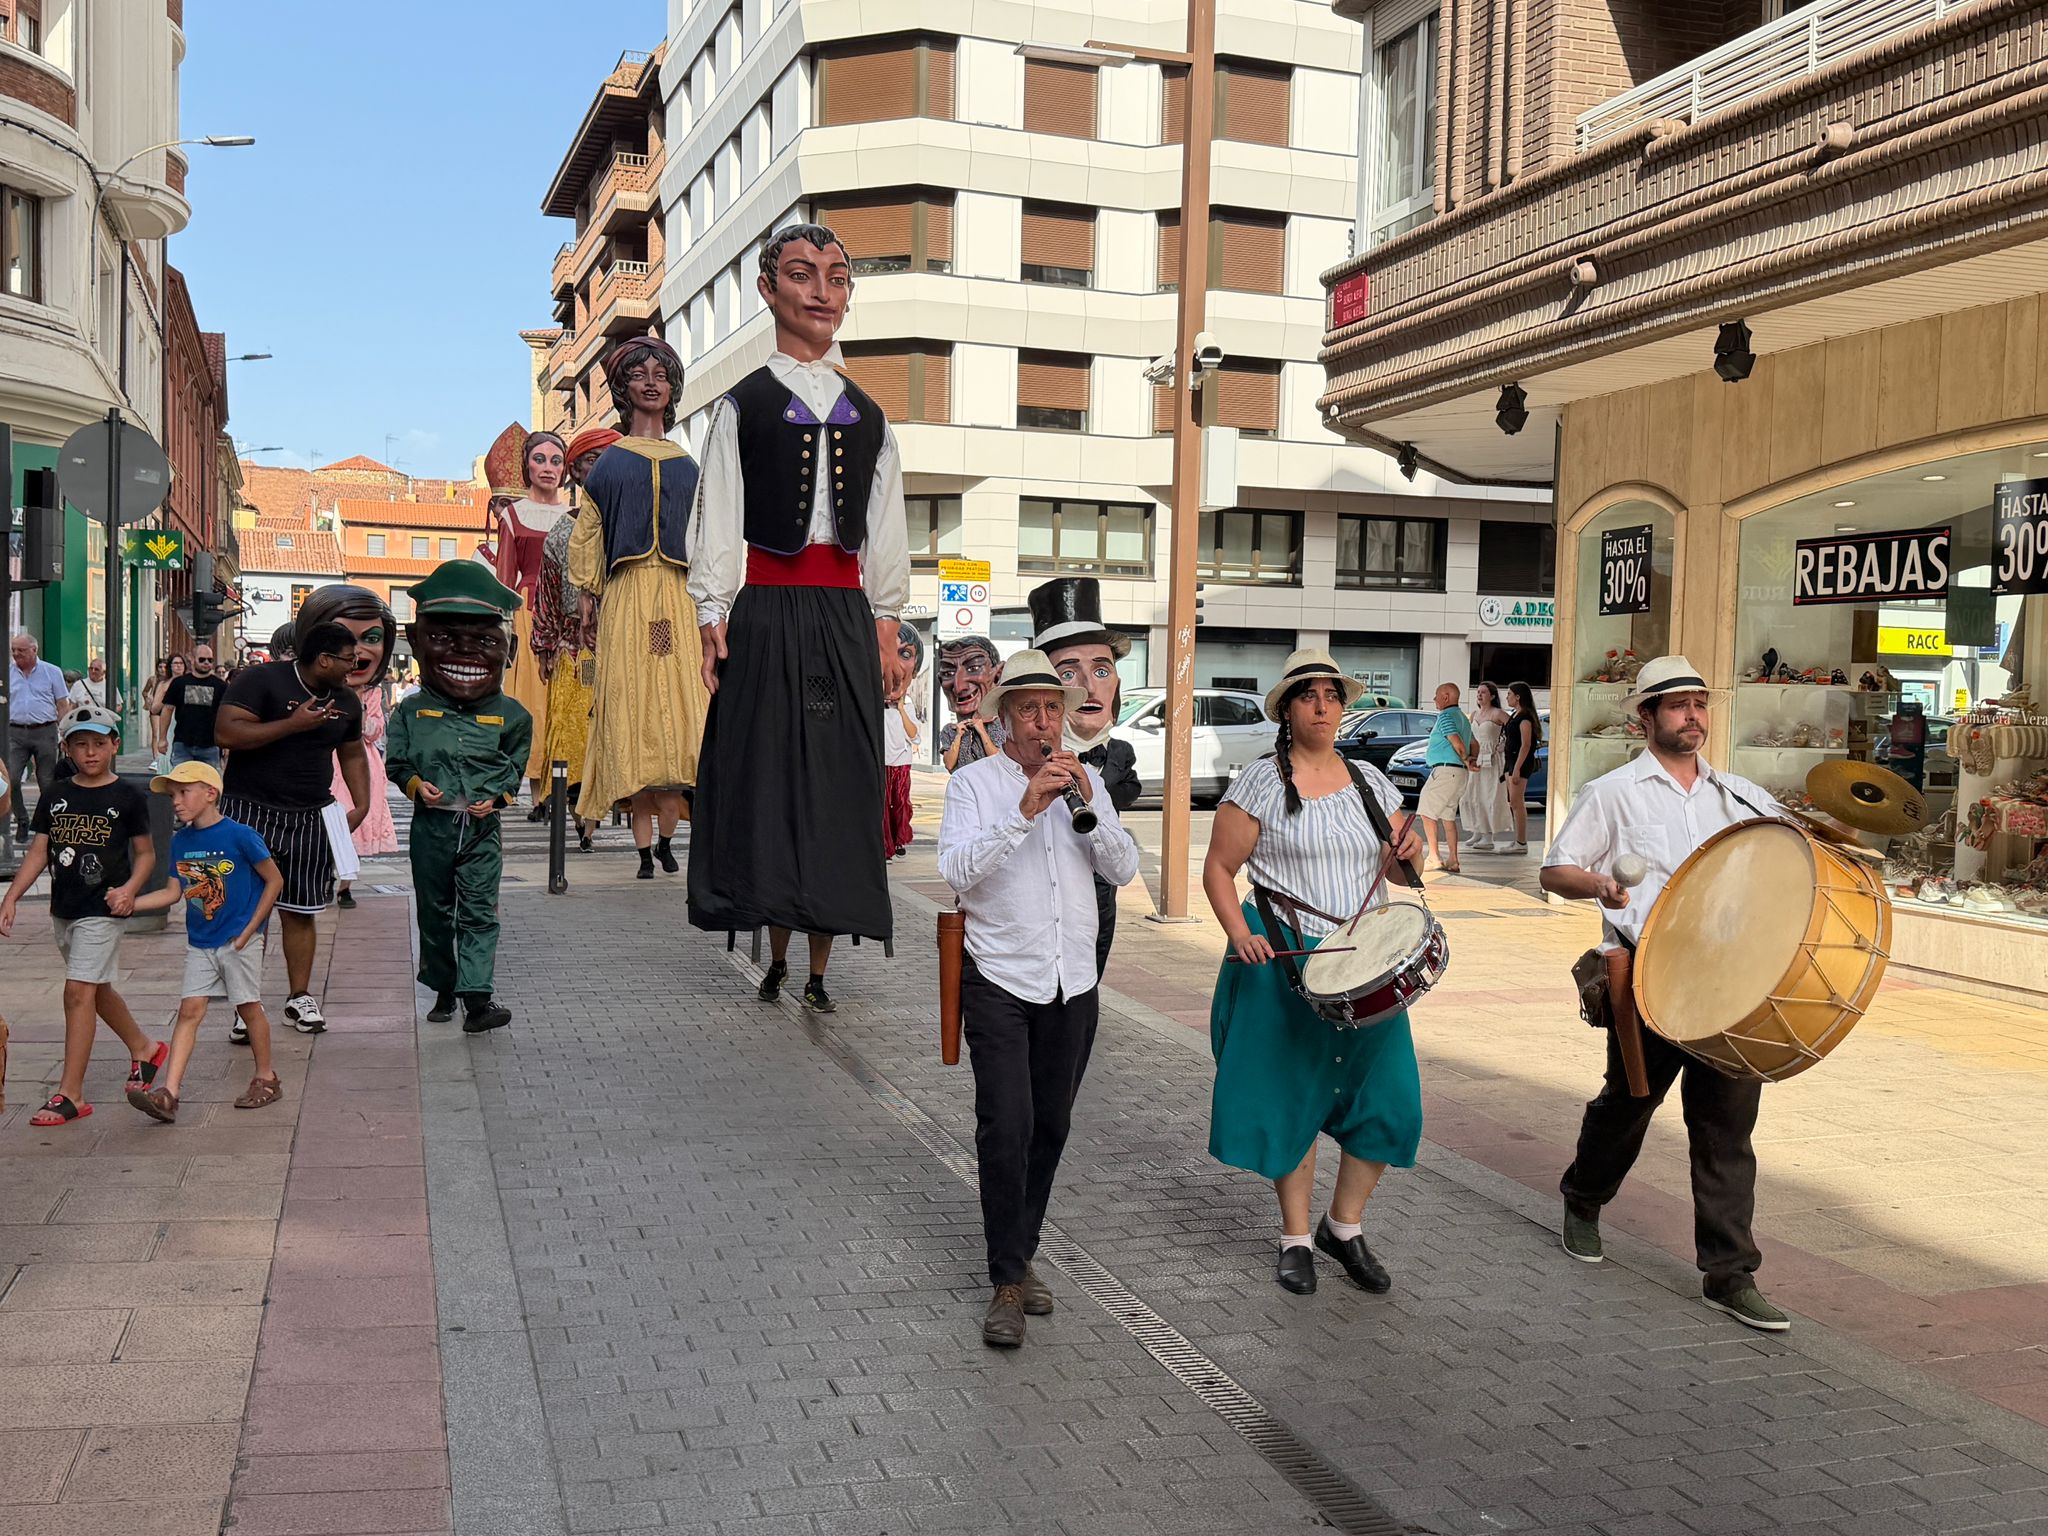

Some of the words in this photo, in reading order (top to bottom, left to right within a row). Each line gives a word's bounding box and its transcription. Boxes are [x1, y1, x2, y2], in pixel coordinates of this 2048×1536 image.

[2001, 492, 2048, 519] HASTA
[1605, 538, 1634, 558] HASTA
[1636, 536, 1647, 554] EL
[1795, 536, 1949, 598] REBAJAS
[1604, 557, 1646, 605] 30%
[1907, 634, 1939, 650] RACC
[52, 813, 112, 831] STAR
[50, 827, 111, 846] WARS
